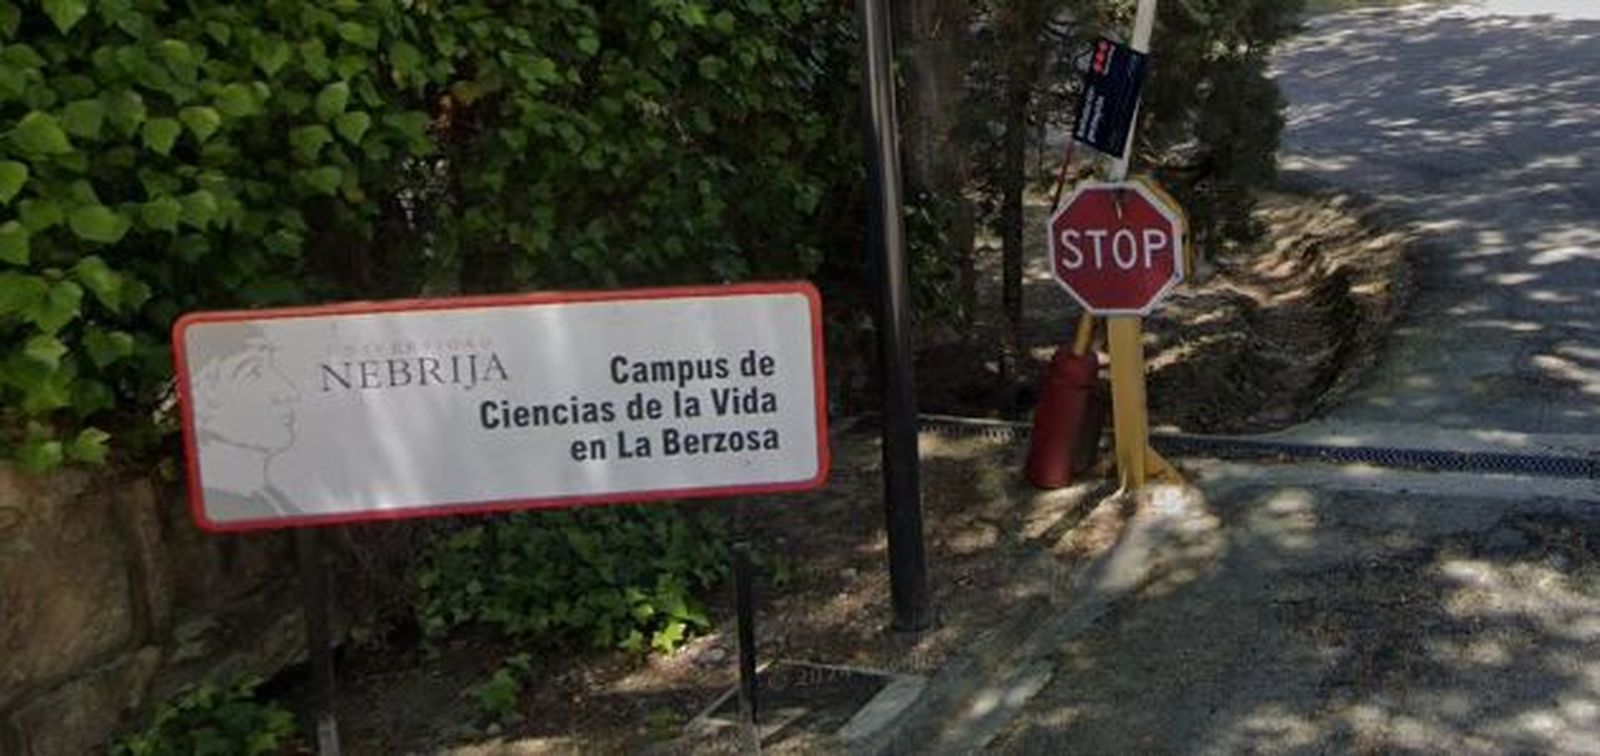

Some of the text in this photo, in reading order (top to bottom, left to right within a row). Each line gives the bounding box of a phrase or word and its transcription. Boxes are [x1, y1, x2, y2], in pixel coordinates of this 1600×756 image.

[1061, 228, 1168, 270] STOP
[320, 352, 509, 392] NEBRIJA
[610, 349, 776, 387] Campus de
[480, 386, 778, 429] Ciencias de la Vida
[570, 428, 780, 462] en La Berzosa
